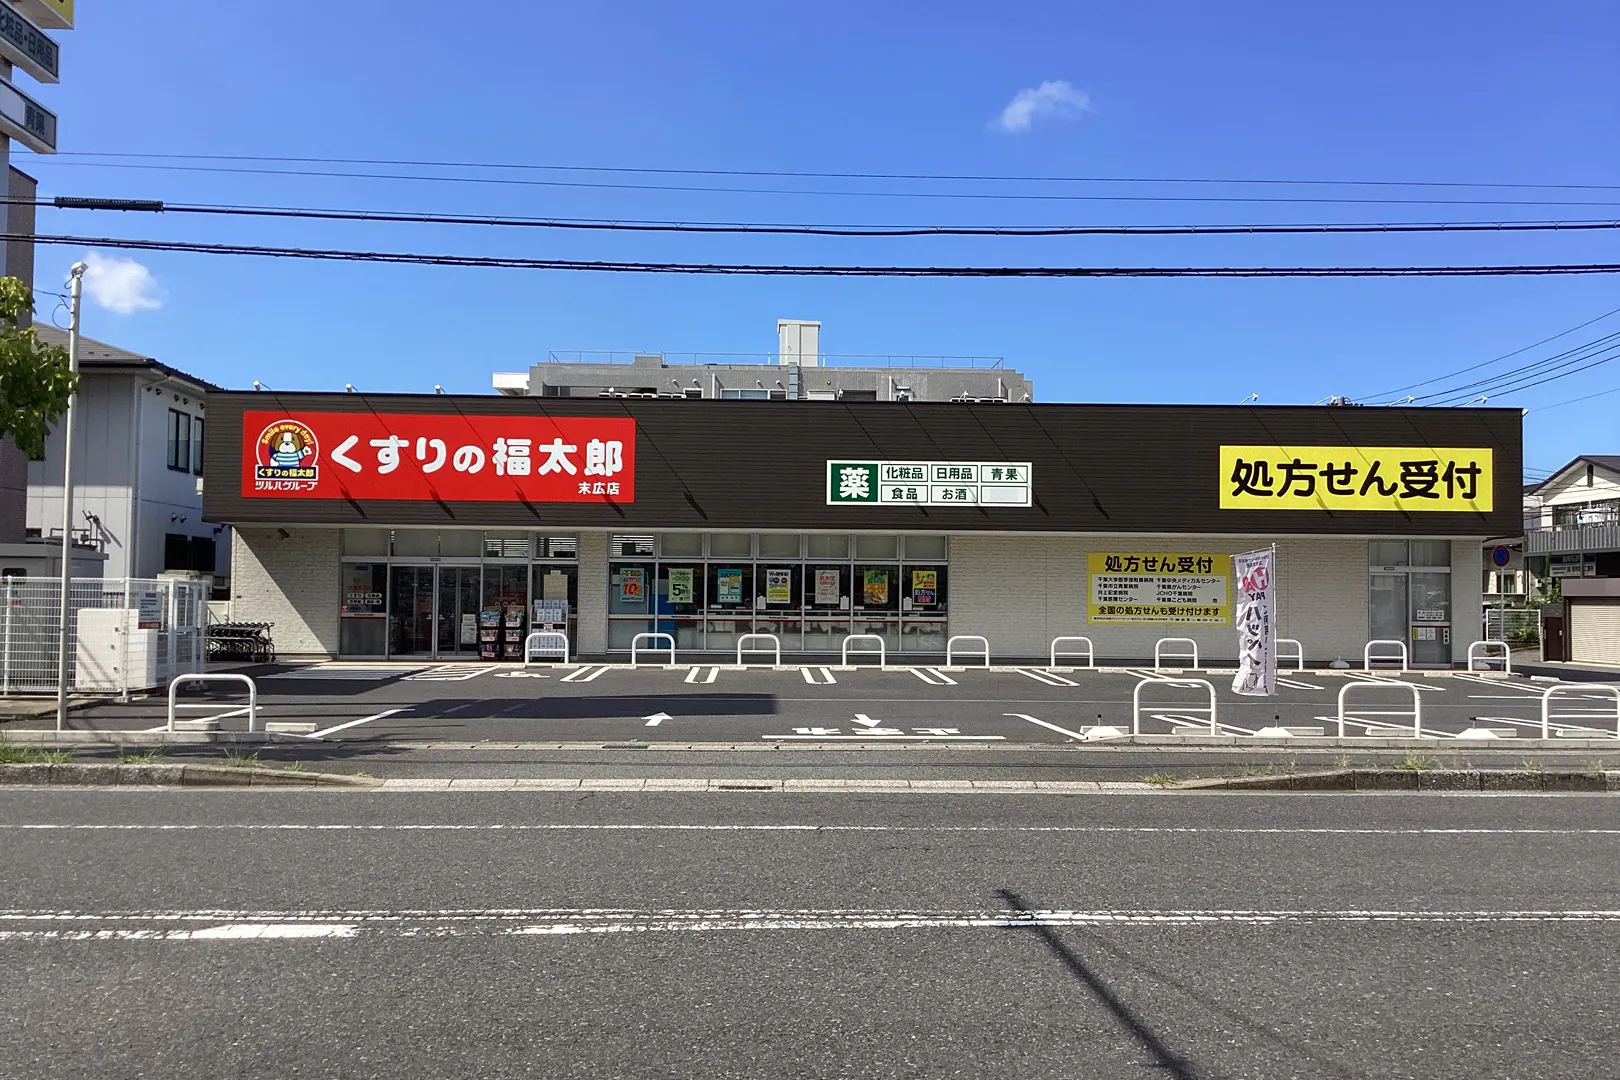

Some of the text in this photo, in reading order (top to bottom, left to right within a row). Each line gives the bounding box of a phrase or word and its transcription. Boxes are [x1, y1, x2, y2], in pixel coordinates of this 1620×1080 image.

[262, 424, 315, 445] Smile every day!
[330, 434, 623, 477] くすりの福太郎
[258, 468, 314, 477] くすりの福太郎
[886, 467, 923, 480] 化粧品
[936, 467, 973, 480] 日用品
[991, 468, 1018, 480] 青果
[1230, 458, 1482, 500] 処方せん受付
[255, 480, 318, 491] ツルハグループ
[578, 481, 621, 496] 末広店
[839, 466, 870, 499] 薬
[891, 487, 918, 500] 食品
[942, 488, 967, 501] お酒
[1105, 555, 1213, 573] 処方せん受付
[1098, 606, 1220, 616] 全国の処方せんも受け付けます
